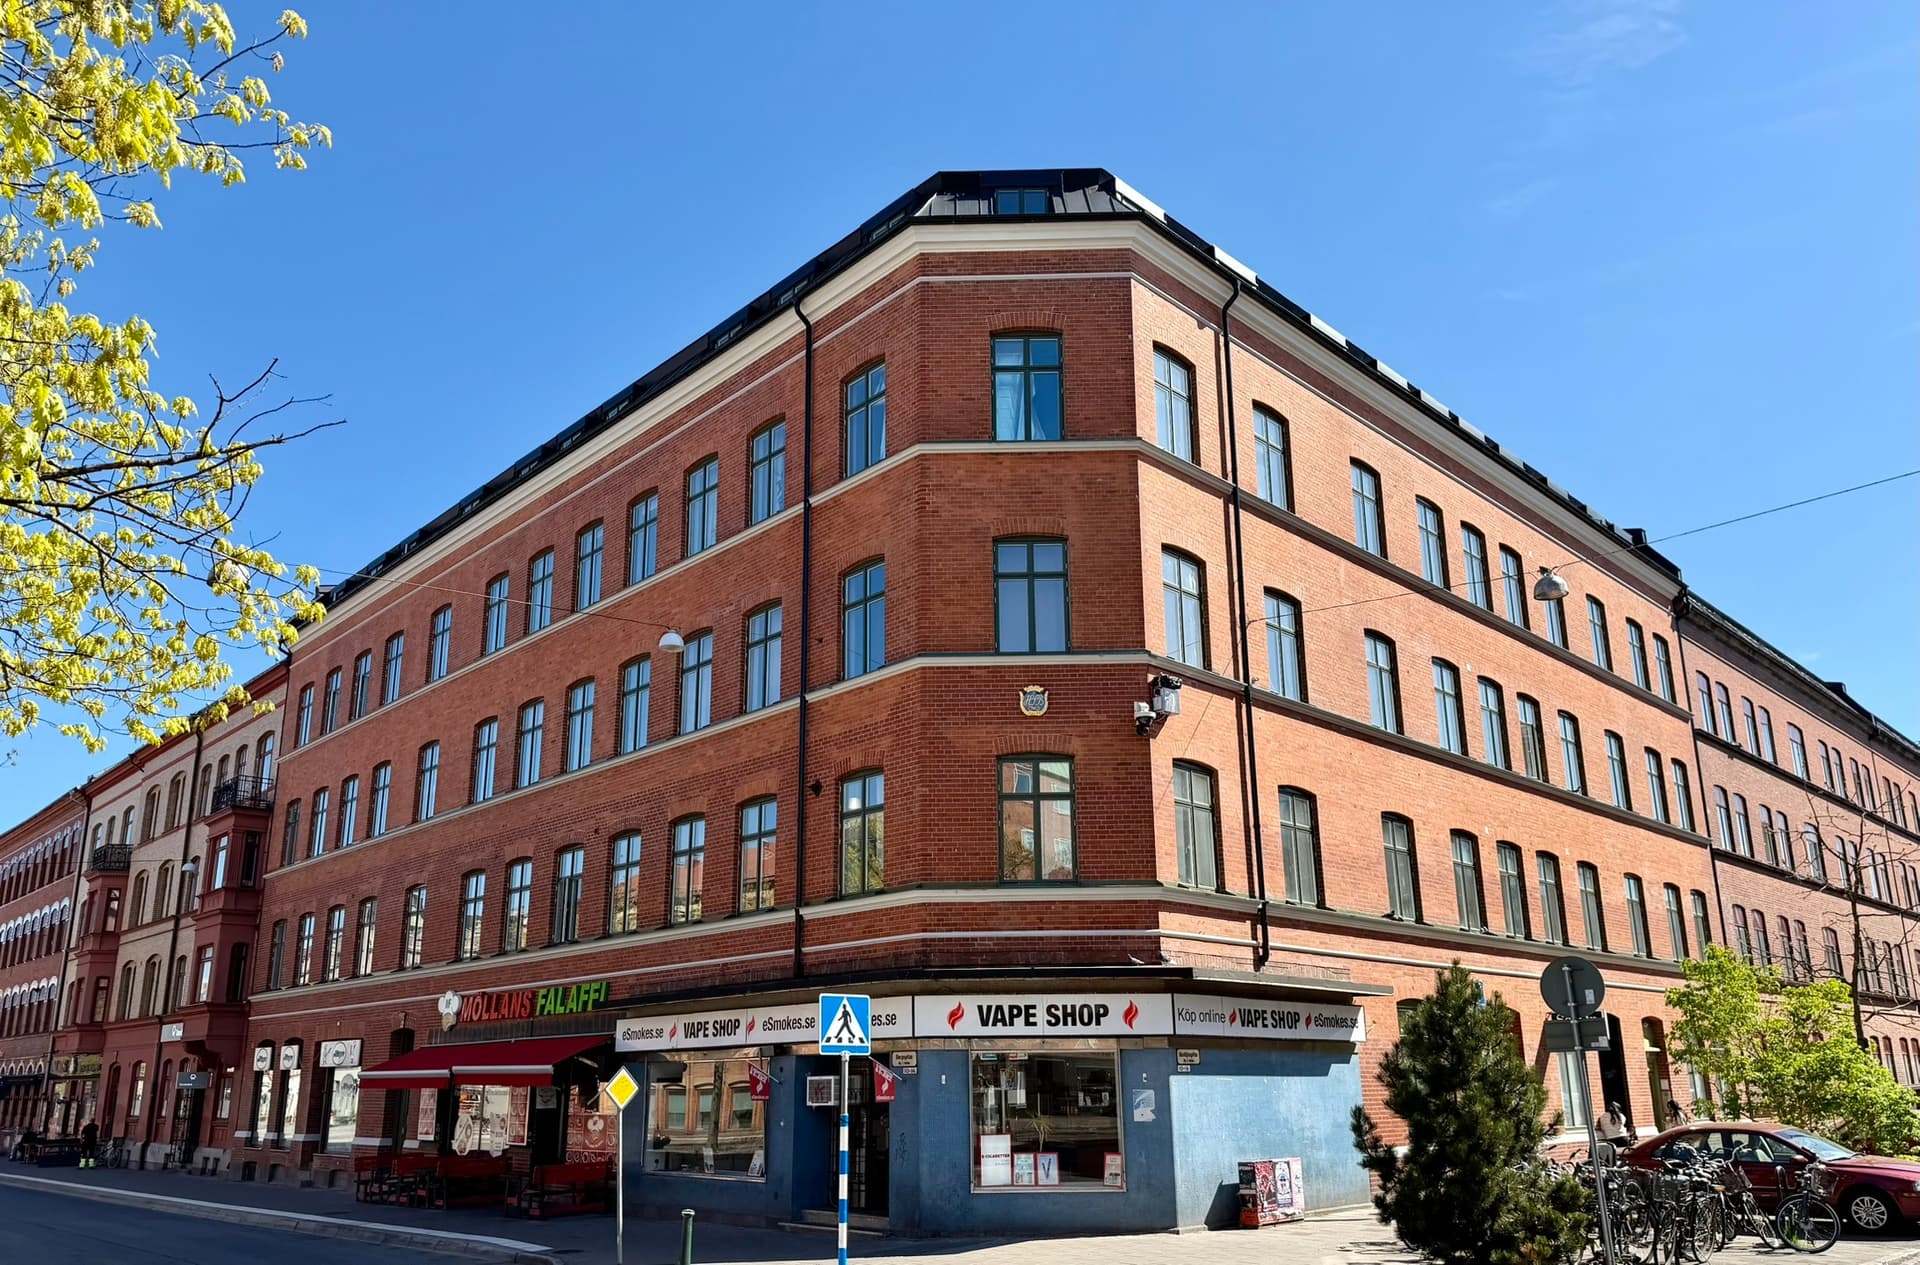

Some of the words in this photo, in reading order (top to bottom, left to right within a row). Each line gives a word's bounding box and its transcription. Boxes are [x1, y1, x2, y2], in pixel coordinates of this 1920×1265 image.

[460, 991, 533, 1022] MÖLLANS
[977, 1004, 1037, 1027] VAPE
[1046, 1003, 1109, 1027] SHOP
[762, 1016, 816, 1031] eSmokes.se
[871, 1013, 897, 1027] es.se
[1177, 1007, 1196, 1024] Köp
[1199, 1009, 1226, 1024] online
[1238, 1008, 1269, 1029] VAPE
[1270, 1009, 1300, 1030] SHOP
[1313, 1013, 1359, 1030] eSmokes.se
[622, 1027, 664, 1041] eSmokes.se
[683, 1021, 709, 1039] VAPE
[712, 1019, 741, 1037] SHOP
